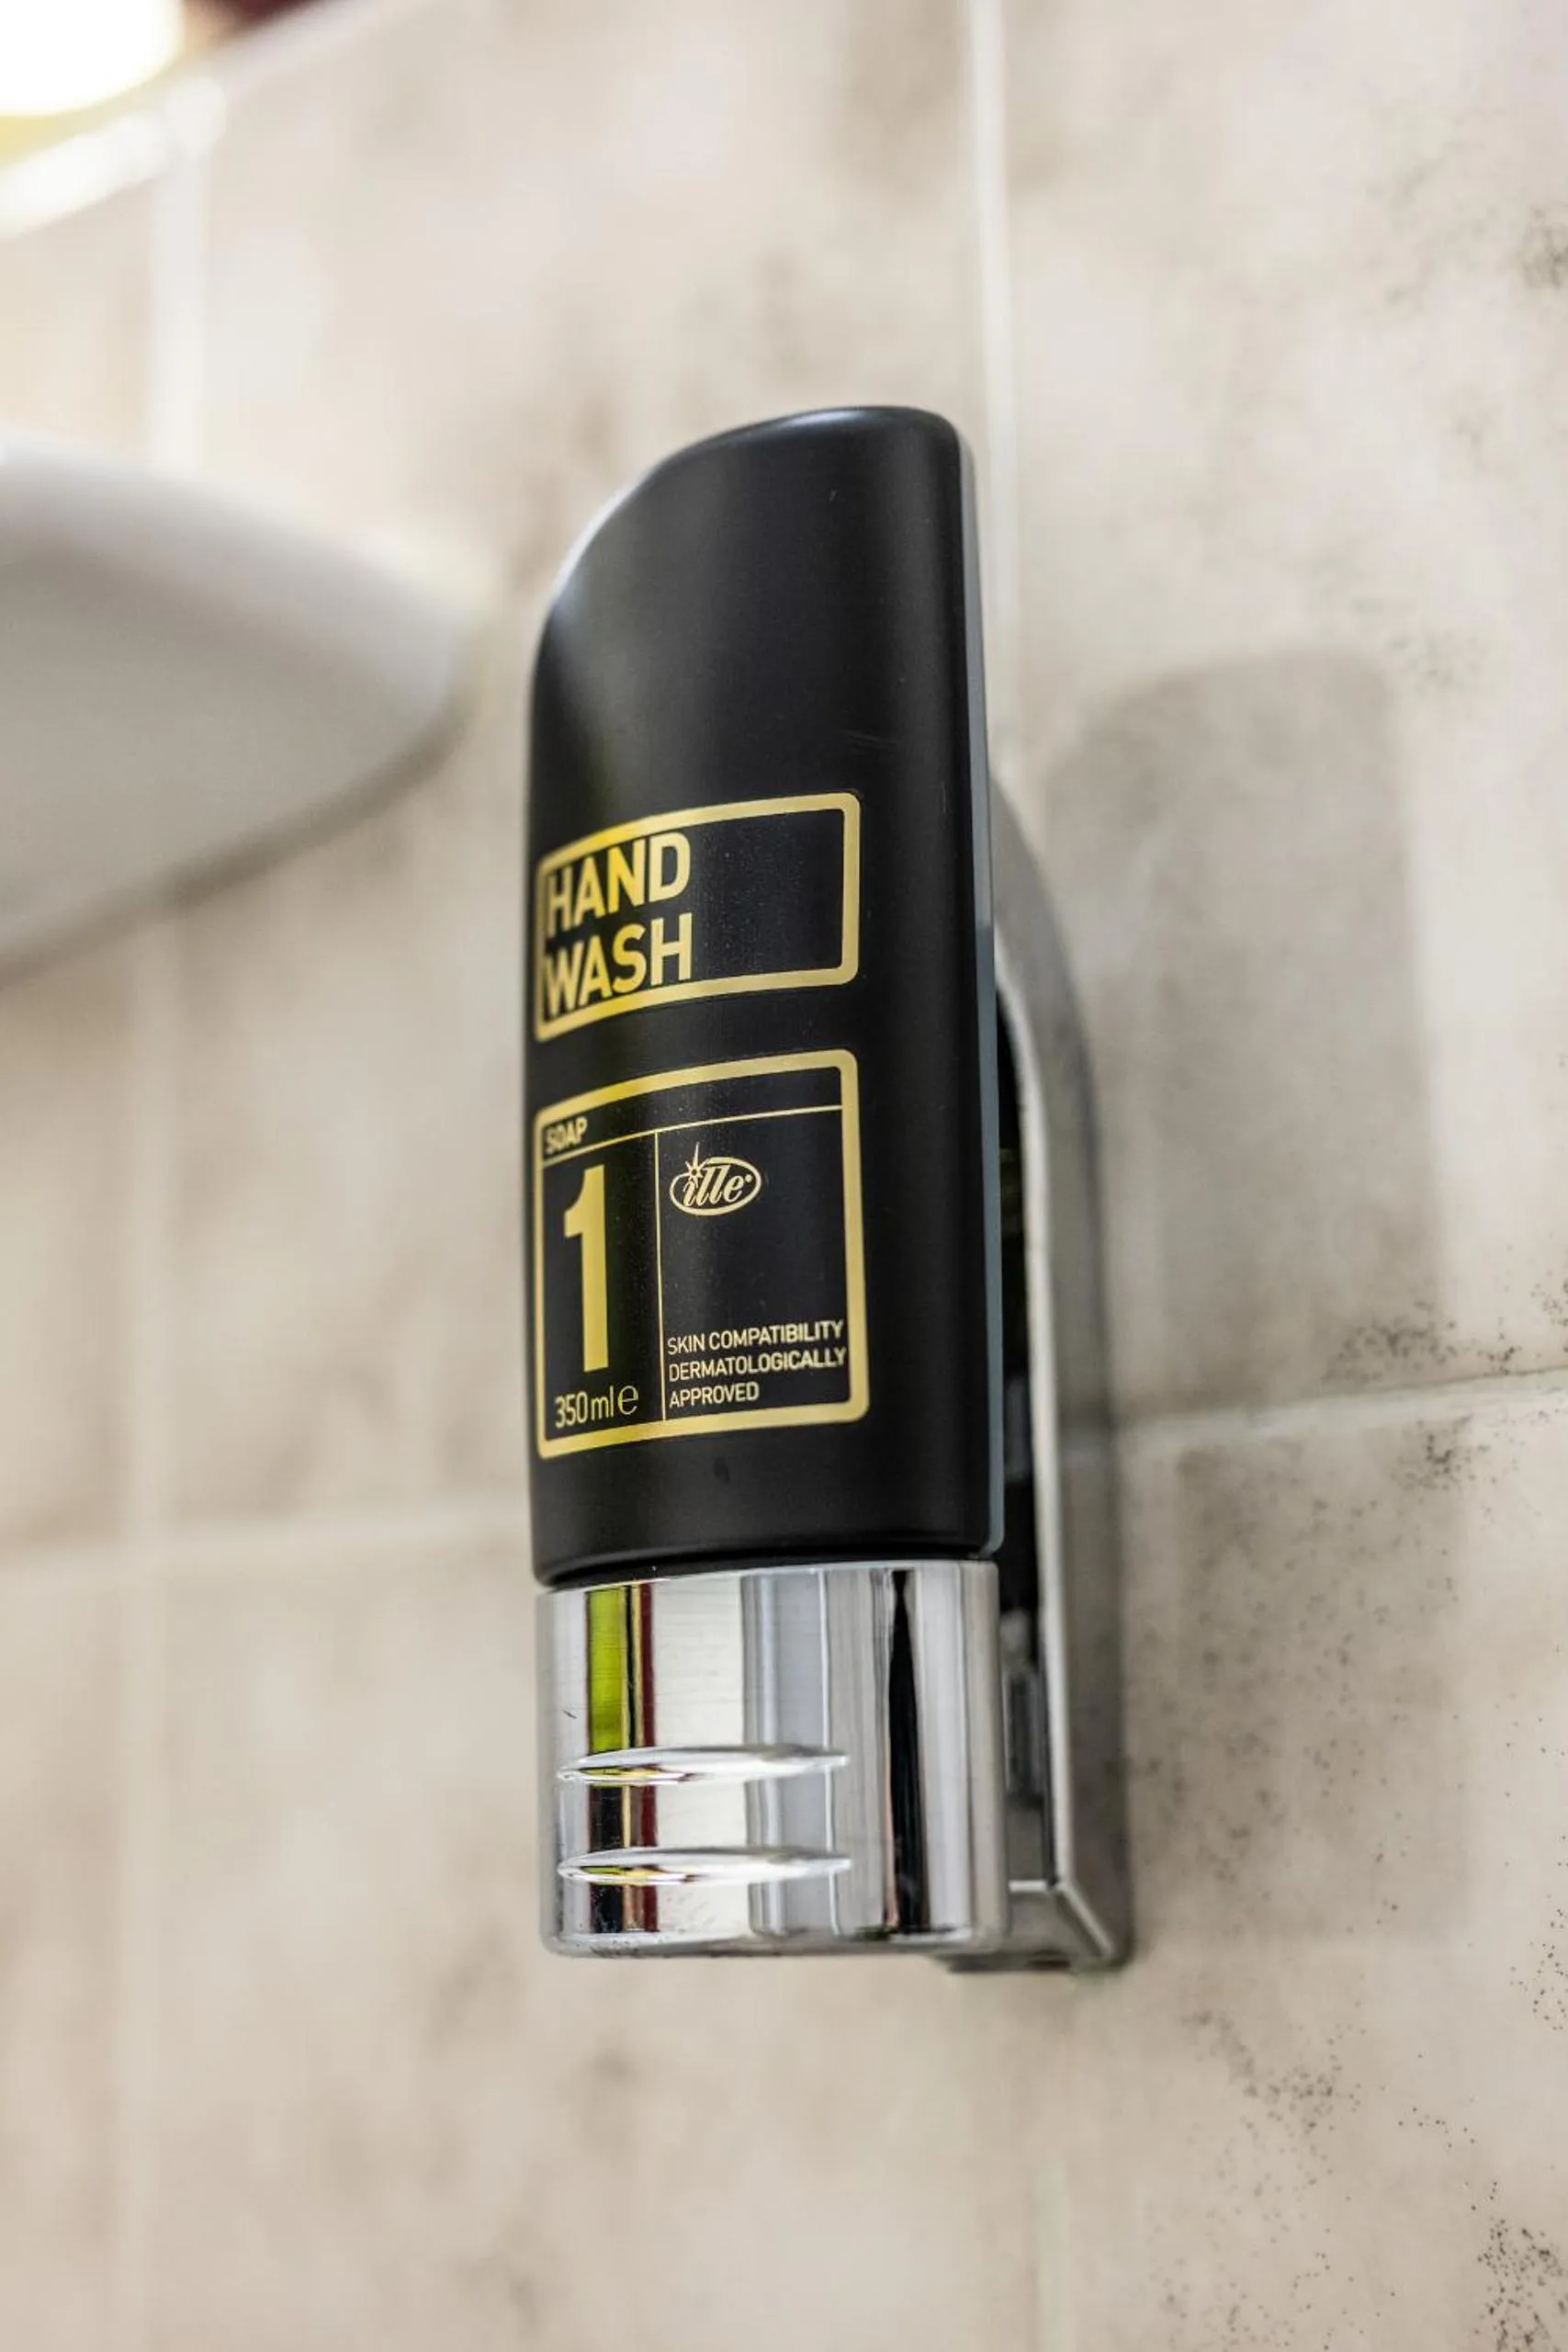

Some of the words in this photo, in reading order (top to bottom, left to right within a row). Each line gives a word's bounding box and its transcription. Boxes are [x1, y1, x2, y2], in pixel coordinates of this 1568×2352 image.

[547, 831, 691, 938] HAND
[546, 912, 693, 1016] WASH
[545, 1116, 588, 1154] SOAP
[564, 1164, 609, 1373] 1
[667, 1333, 705, 1356] SKIN
[708, 1319, 844, 1350] COMPATIBILITY
[668, 1347, 847, 1383] DERMATOLOGICALLY
[669, 1381, 760, 1408] APPROVED
